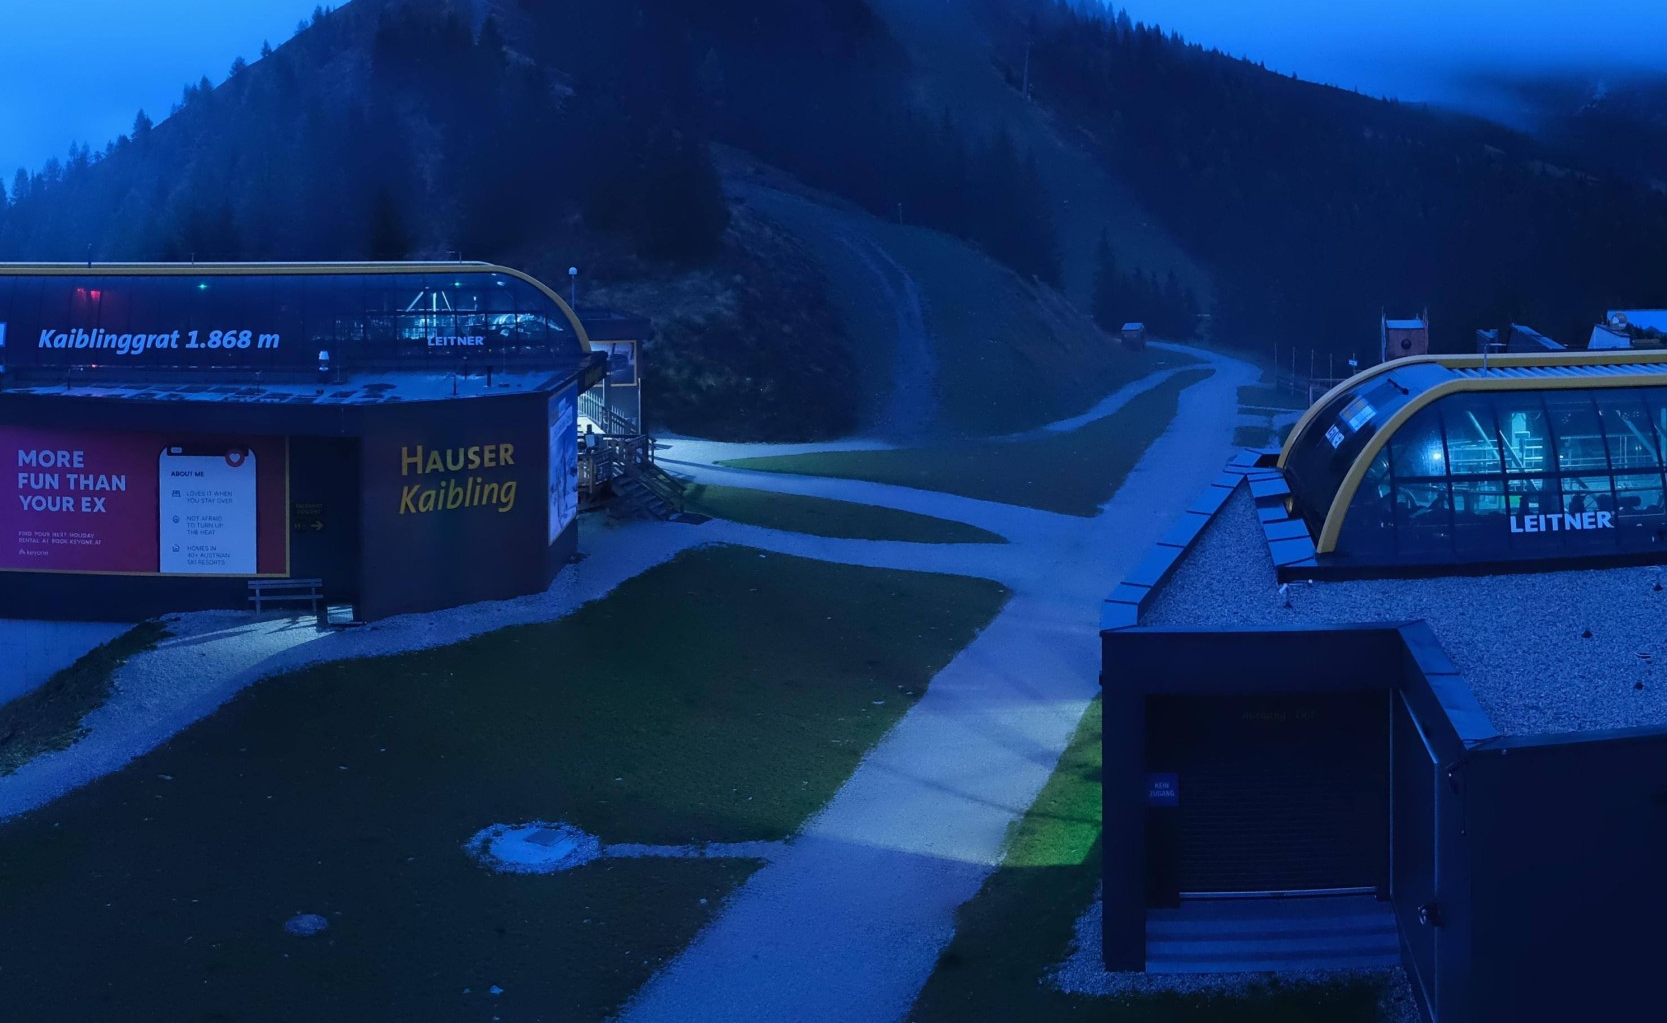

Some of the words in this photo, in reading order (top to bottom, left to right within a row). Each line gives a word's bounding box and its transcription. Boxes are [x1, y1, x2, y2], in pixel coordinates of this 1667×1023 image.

[38, 328, 180, 355] Kaiblinggrat
[185, 329, 252, 348] 1.868
[258, 333, 280, 348] m
[427, 336, 484, 346] LEITNER
[18, 449, 85, 468] MORE
[401, 443, 515, 476] HAUSER
[18, 473, 59, 489] FUN
[66, 474, 126, 491] THAN
[19, 495, 75, 512] YOUR
[81, 497, 107, 513] EX
[400, 477, 517, 514] Kaibling
[1510, 511, 1614, 533] LEITNER
